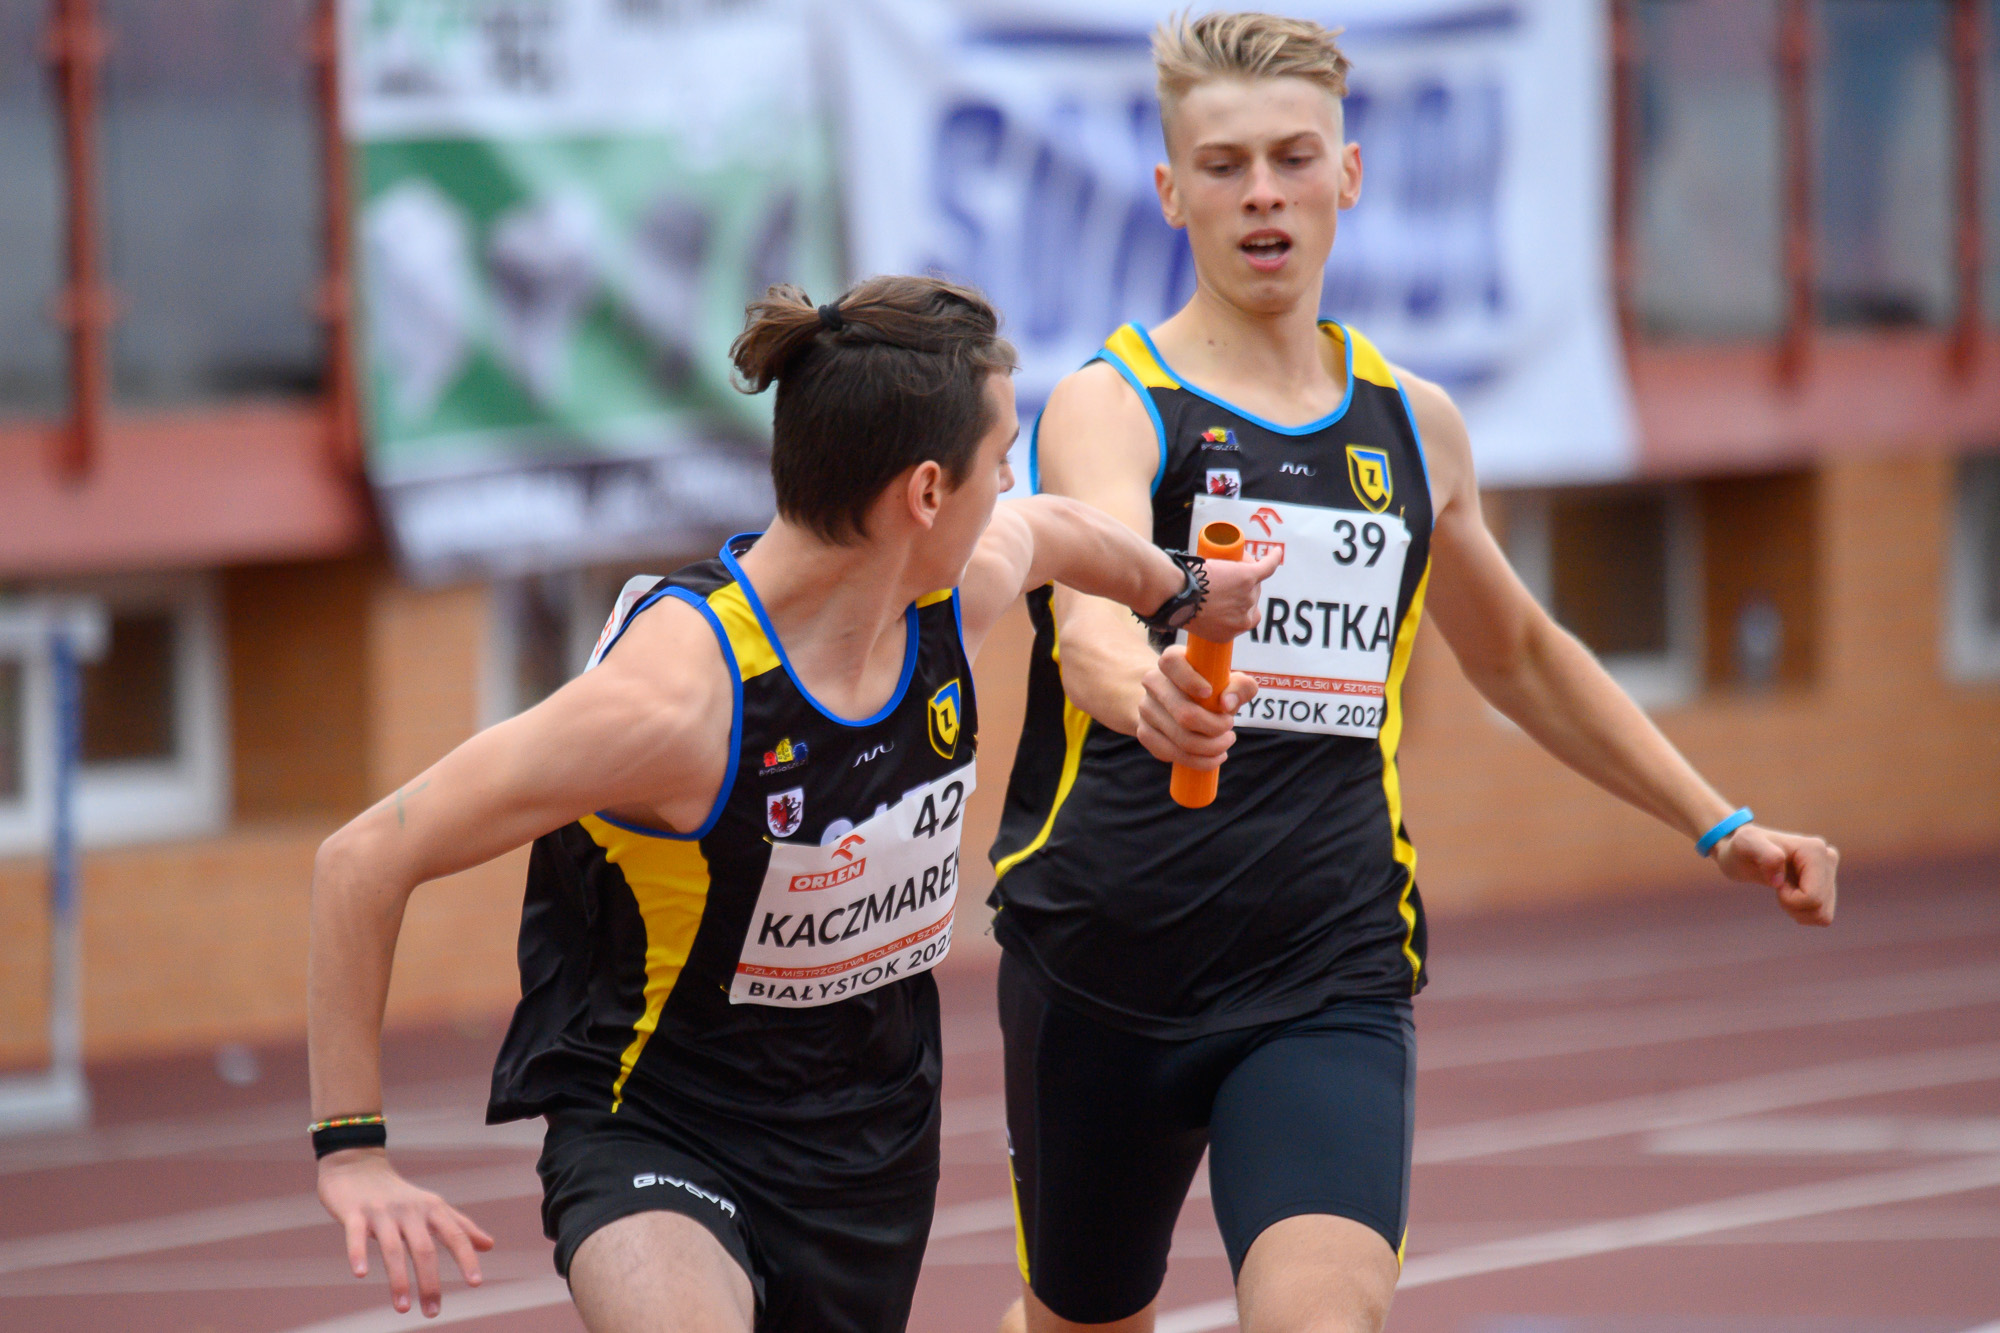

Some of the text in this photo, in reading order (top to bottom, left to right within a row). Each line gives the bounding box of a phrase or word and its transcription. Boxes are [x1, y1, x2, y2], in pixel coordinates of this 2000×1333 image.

[1332, 519, 1386, 568] 39
[1250, 597, 1391, 653] RSTKA
[1293, 679, 1330, 691] POLSKI
[1332, 681, 1343, 691] W
[1235, 697, 1328, 725] YSTOK
[912, 780, 964, 839] 42
[794, 861, 863, 891] ORLEN
[745, 966, 778, 977] PZLA
[781, 955, 865, 978] MISTRZOSTWA
[866, 941, 903, 961] POLSKI
[905, 935, 915, 945] W
[748, 957, 901, 1001] BIAŁYSTOK
[633, 1172, 736, 1218] GIVOVA
